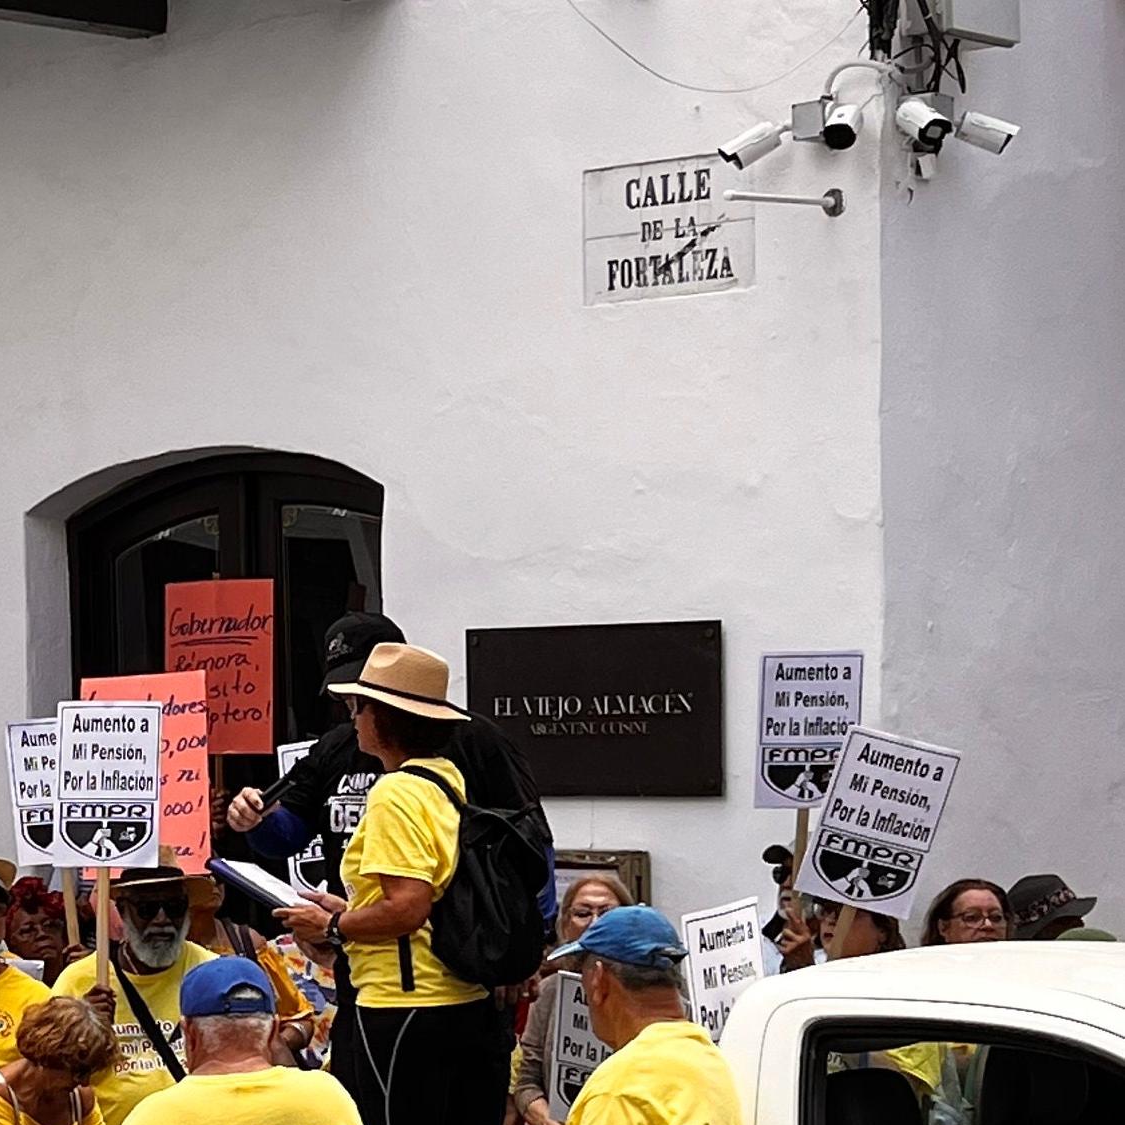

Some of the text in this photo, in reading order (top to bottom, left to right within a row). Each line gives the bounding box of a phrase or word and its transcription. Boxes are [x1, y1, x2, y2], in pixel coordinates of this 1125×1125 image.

[625, 168, 711, 209] CALLE
[641, 216, 698, 242] DE LA
[607, 247, 734, 291] FORTALEZA
[169, 603, 273, 636] Gobernador
[775, 662, 851, 681] Aumento a
[494, 697, 519, 716] EL
[522, 696, 582, 721] VIEJO
[775, 691, 849, 709] Mi Pensión,
[72, 713, 150, 733] Aumento a
[766, 716, 855, 736] Por la Inflació
[21, 731, 57, 748] Aume
[24, 757, 38, 771] Mi
[72, 743, 147, 764] Mi Pensión,
[858, 742, 943, 781] Aumento a
[20, 780, 51, 799] Por la
[64, 770, 83, 791] Por
[86, 770, 97, 791] la
[101, 770, 154, 791] Inflación
[849, 773, 931, 812] Mi Pensión,
[66, 804, 147, 818] FMPR
[830, 798, 931, 843] Por la Inflación
[826, 833, 915, 865] FMPR
[699, 920, 754, 953] Aumento a
[703, 966, 718, 990] Mi
[700, 1005, 719, 1030] Por
[563, 1036, 585, 1055] Por
[586, 1042, 597, 1061] la
